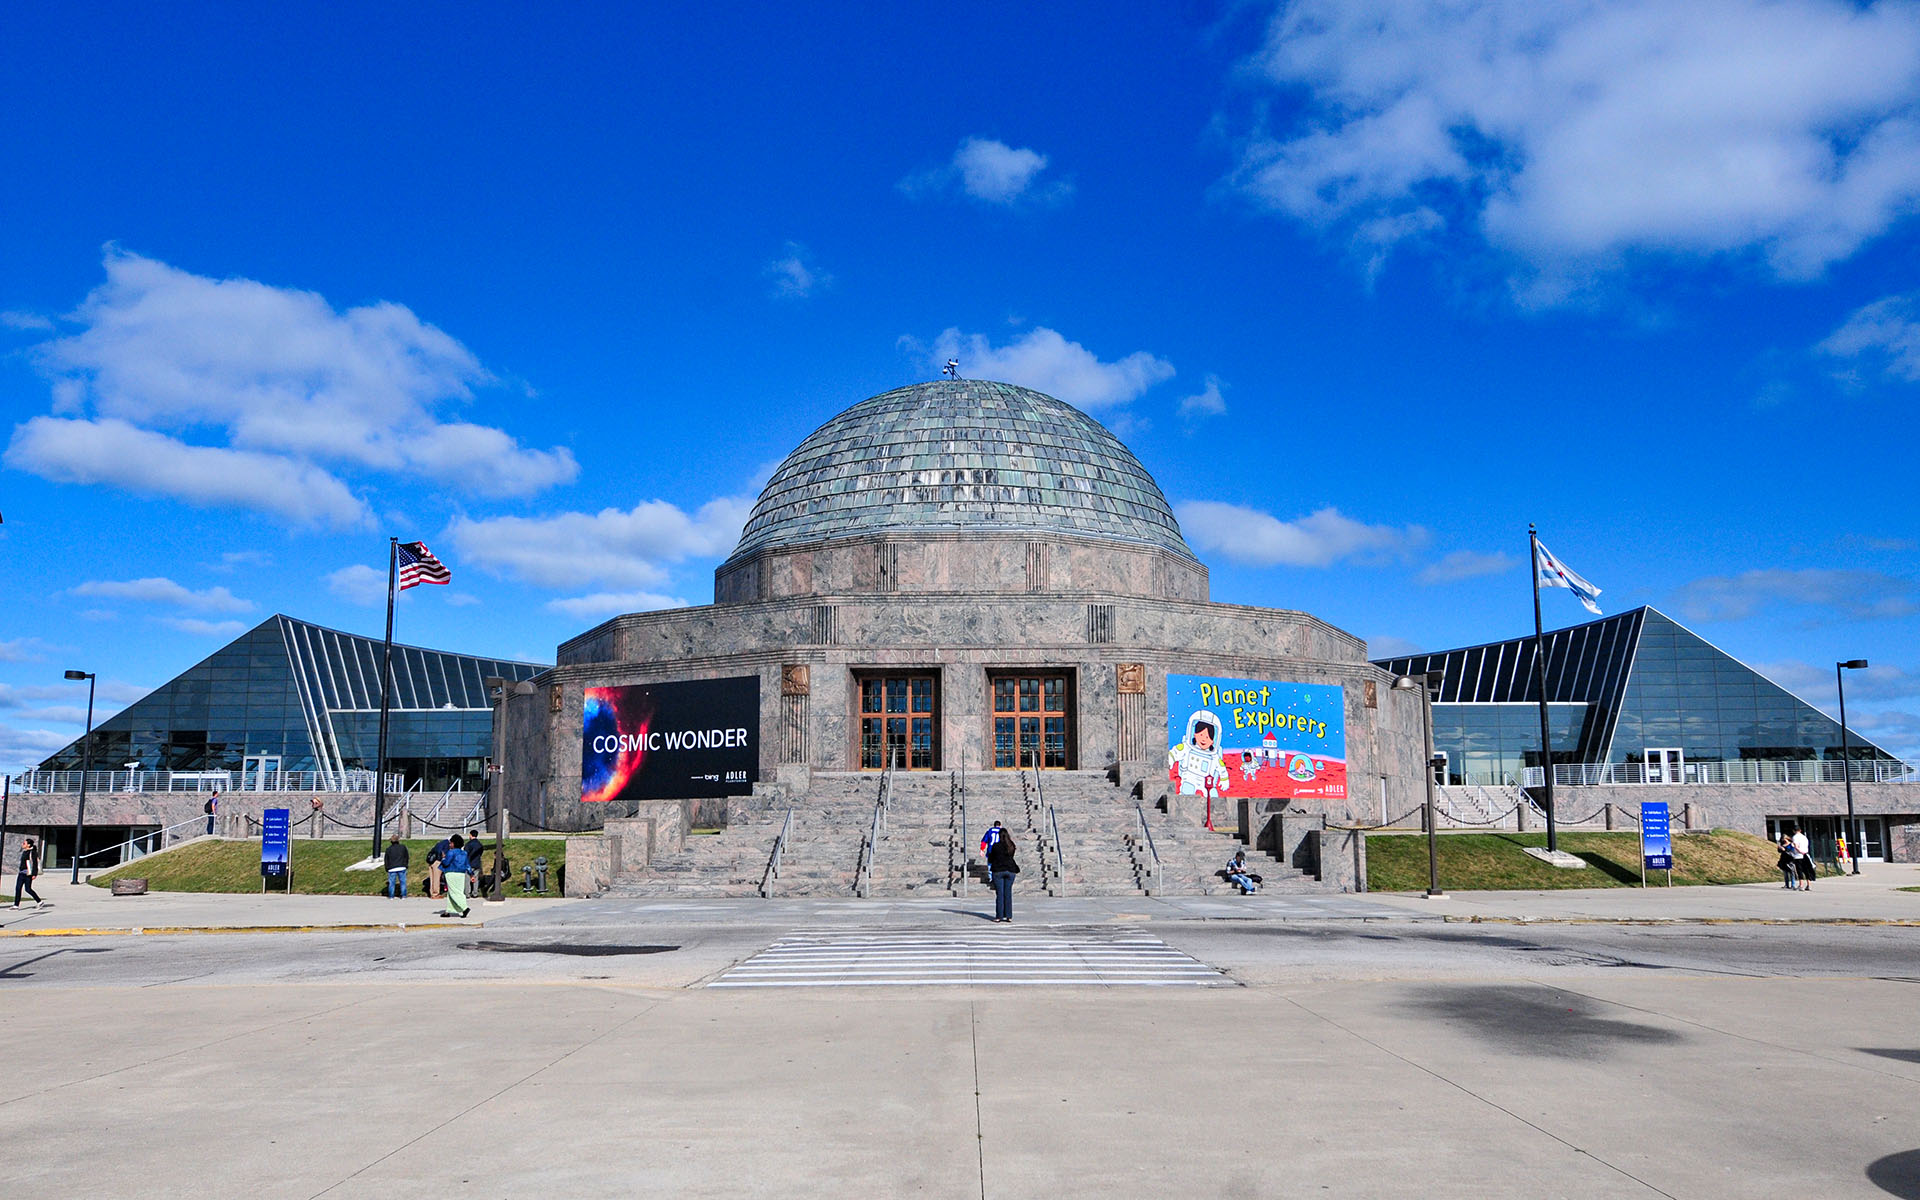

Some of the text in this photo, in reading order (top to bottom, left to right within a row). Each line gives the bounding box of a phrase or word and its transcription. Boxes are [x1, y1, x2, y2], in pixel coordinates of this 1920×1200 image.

[1200, 683, 1271, 707] Planet
[1233, 707, 1328, 739] Explorers
[593, 728, 748, 754] COSMIC WONDER
[704, 774, 719, 782] bing
[725, 770, 747, 780] ADLER
[1325, 784, 1344, 793] ADLER
